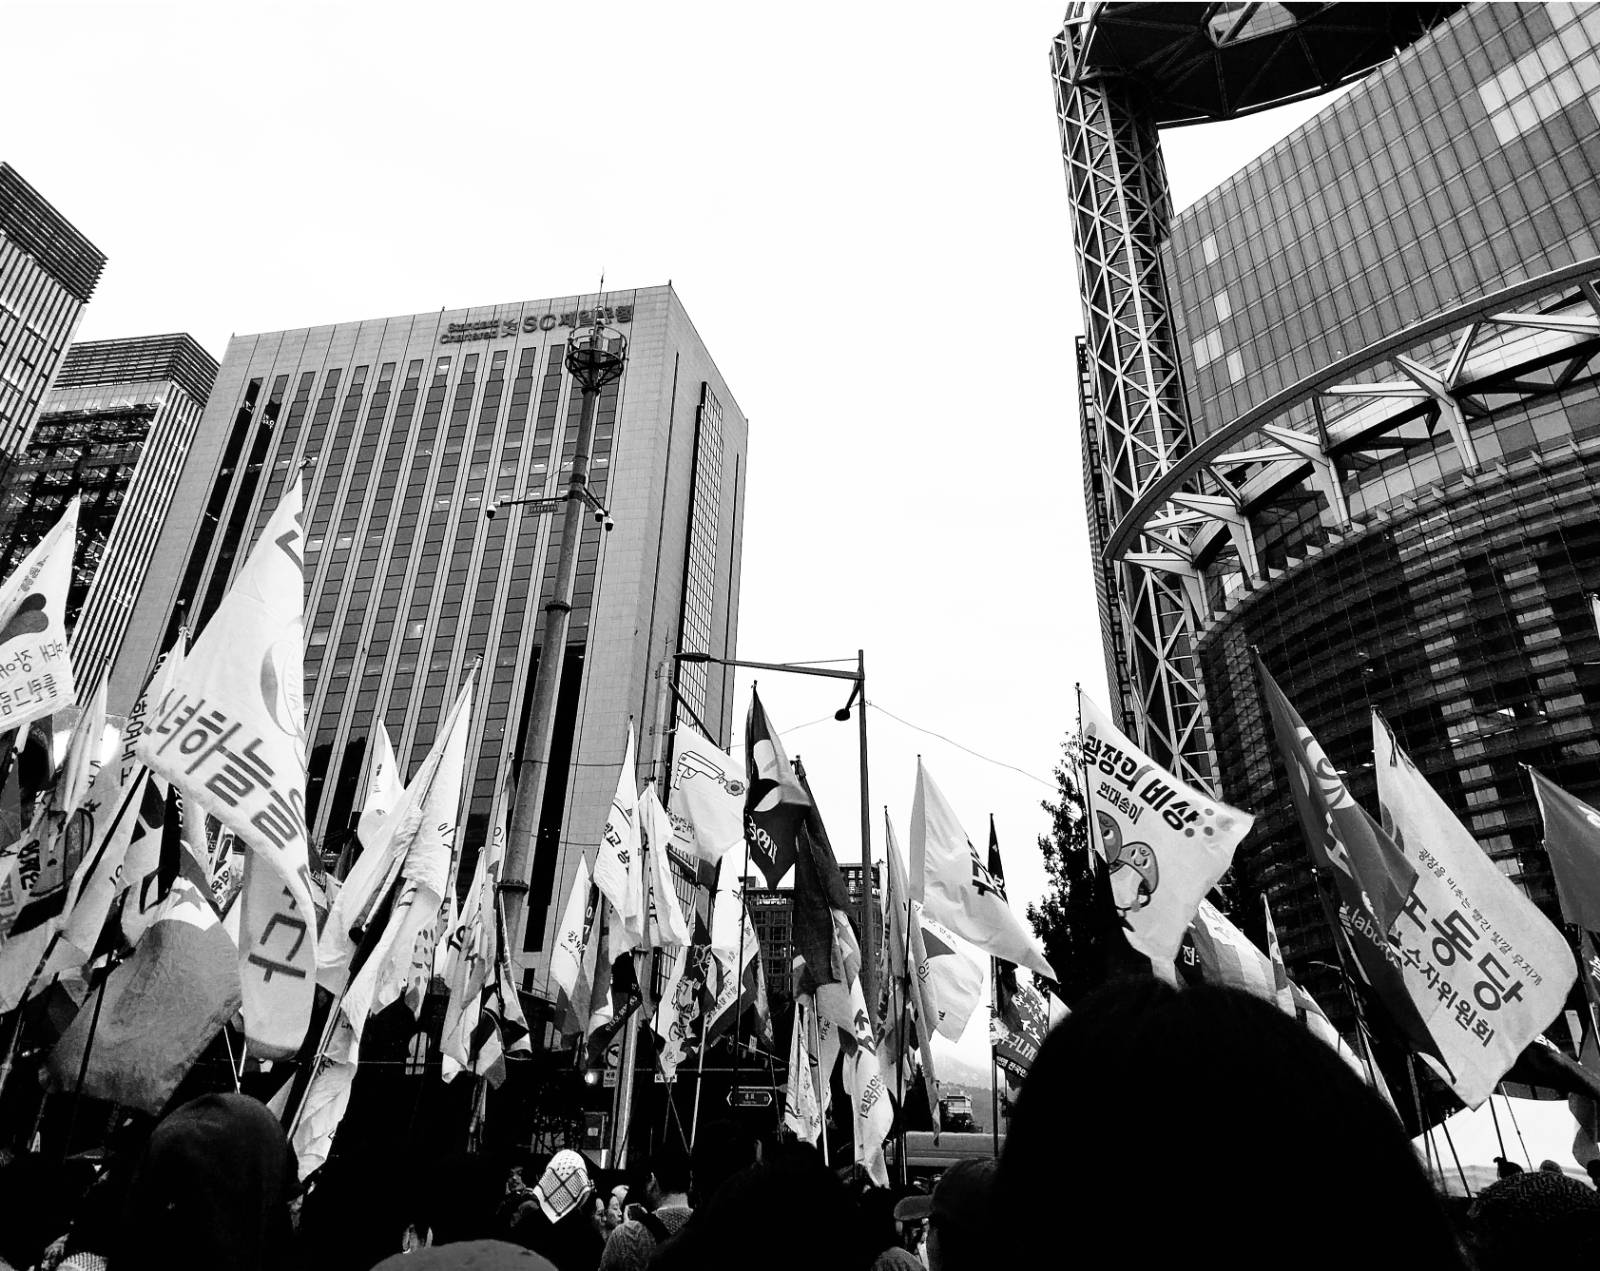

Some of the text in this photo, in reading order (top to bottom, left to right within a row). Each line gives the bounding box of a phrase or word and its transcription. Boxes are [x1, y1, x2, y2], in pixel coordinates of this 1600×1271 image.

[1083, 735, 1200, 831] 광장의 비상
[1418, 847, 1543, 986] 광장을 비추는 빨간 빛깔 무지개
